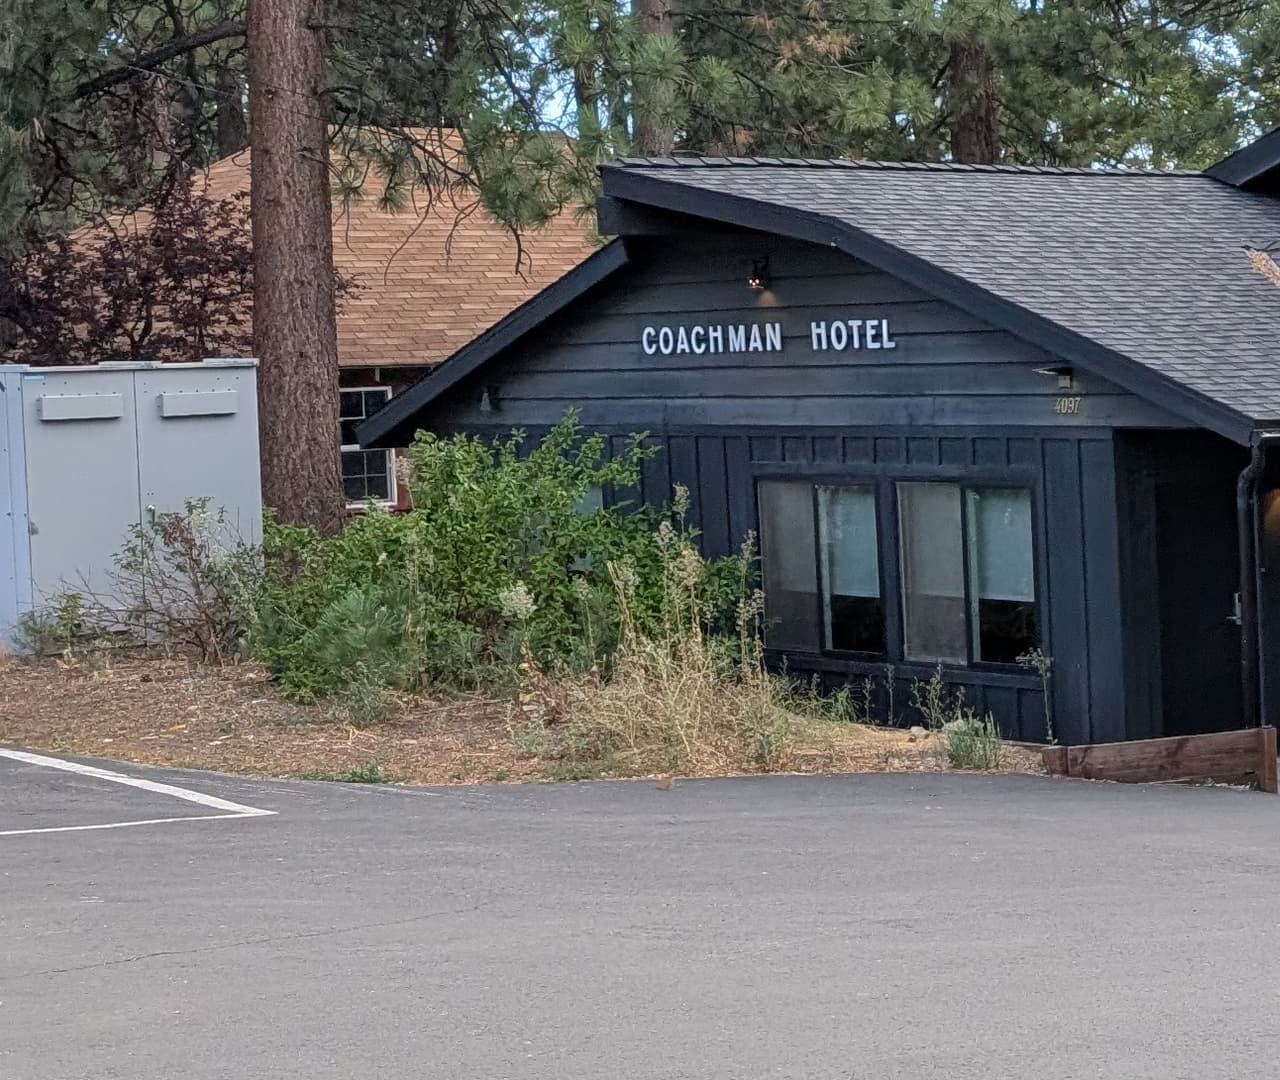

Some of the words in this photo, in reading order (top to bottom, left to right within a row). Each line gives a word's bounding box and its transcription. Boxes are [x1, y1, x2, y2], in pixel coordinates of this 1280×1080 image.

[641, 324, 782, 355] COACHMAN
[811, 319, 896, 350] HOTEL
[1056, 397, 1080, 413] 4097
